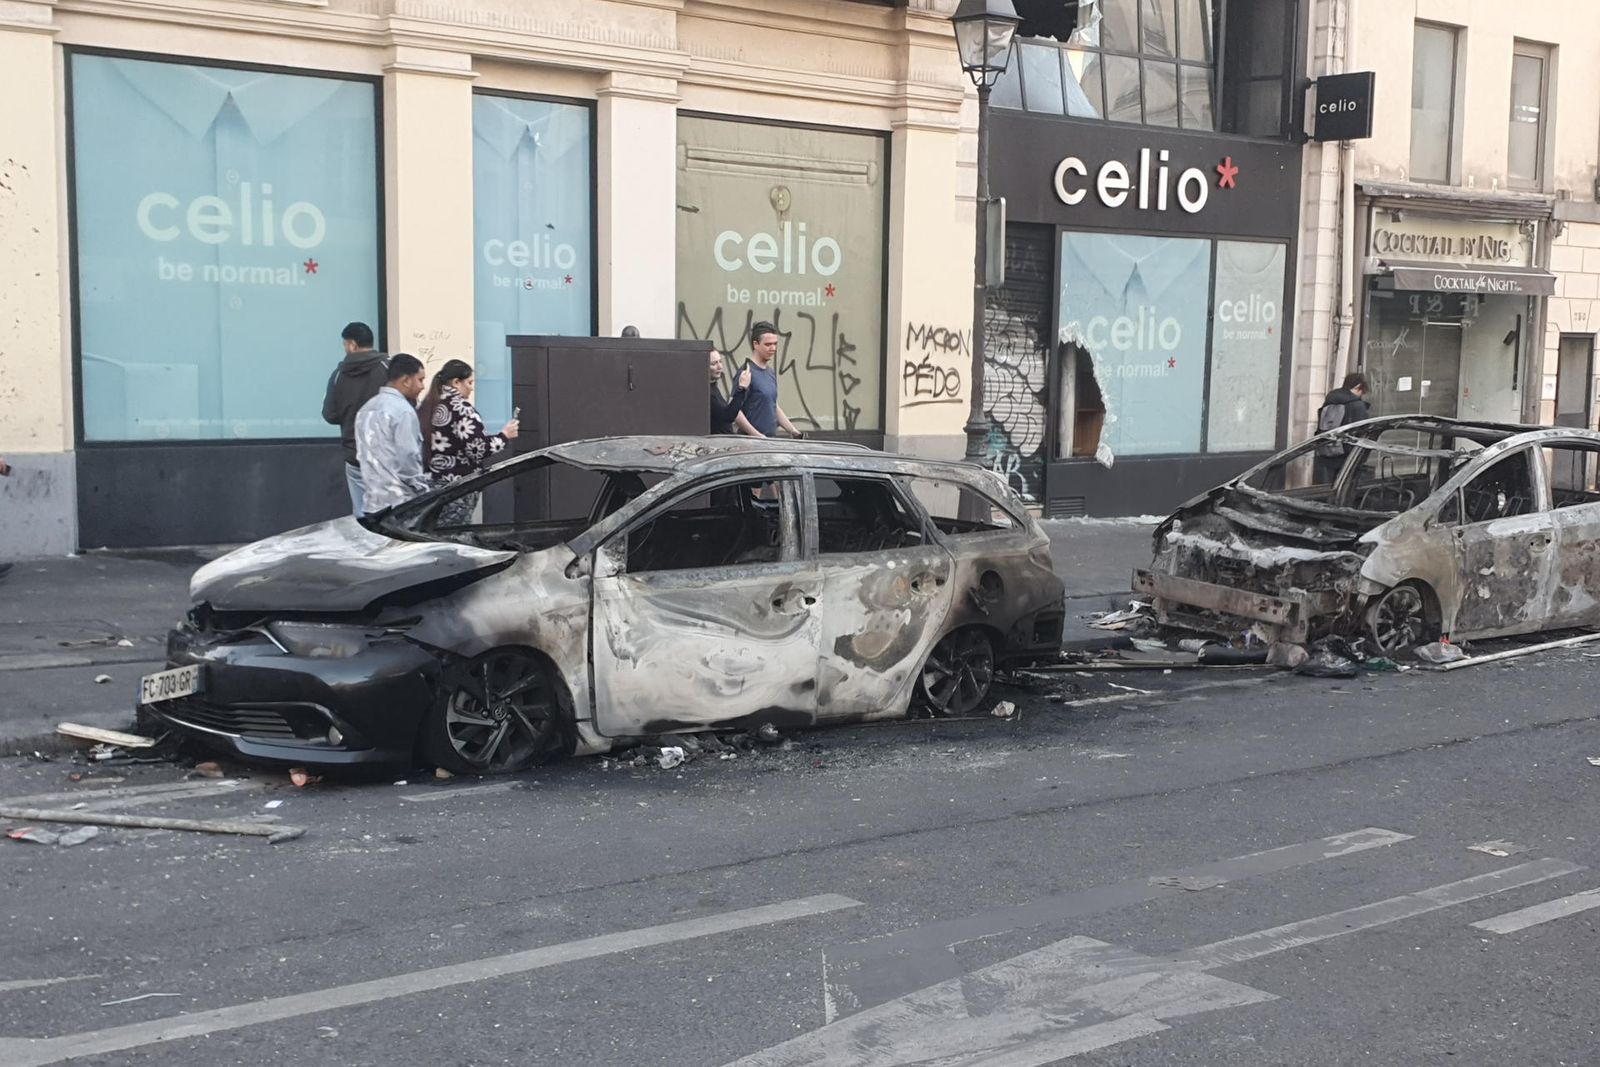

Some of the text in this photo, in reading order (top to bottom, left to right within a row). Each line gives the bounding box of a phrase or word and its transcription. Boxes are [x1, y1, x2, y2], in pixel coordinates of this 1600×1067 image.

[1319, 99, 1357, 114] celio
[137, 181, 326, 249] celio
[483, 233, 577, 270] celio
[714, 221, 842, 276] celio
[158, 256, 193, 281] be
[493, 273, 511, 287] be
[727, 283, 751, 303] be
[1218, 293, 1276, 322] celio
[906, 321, 971, 358] MACRON
[1087, 305, 1182, 351] celio
